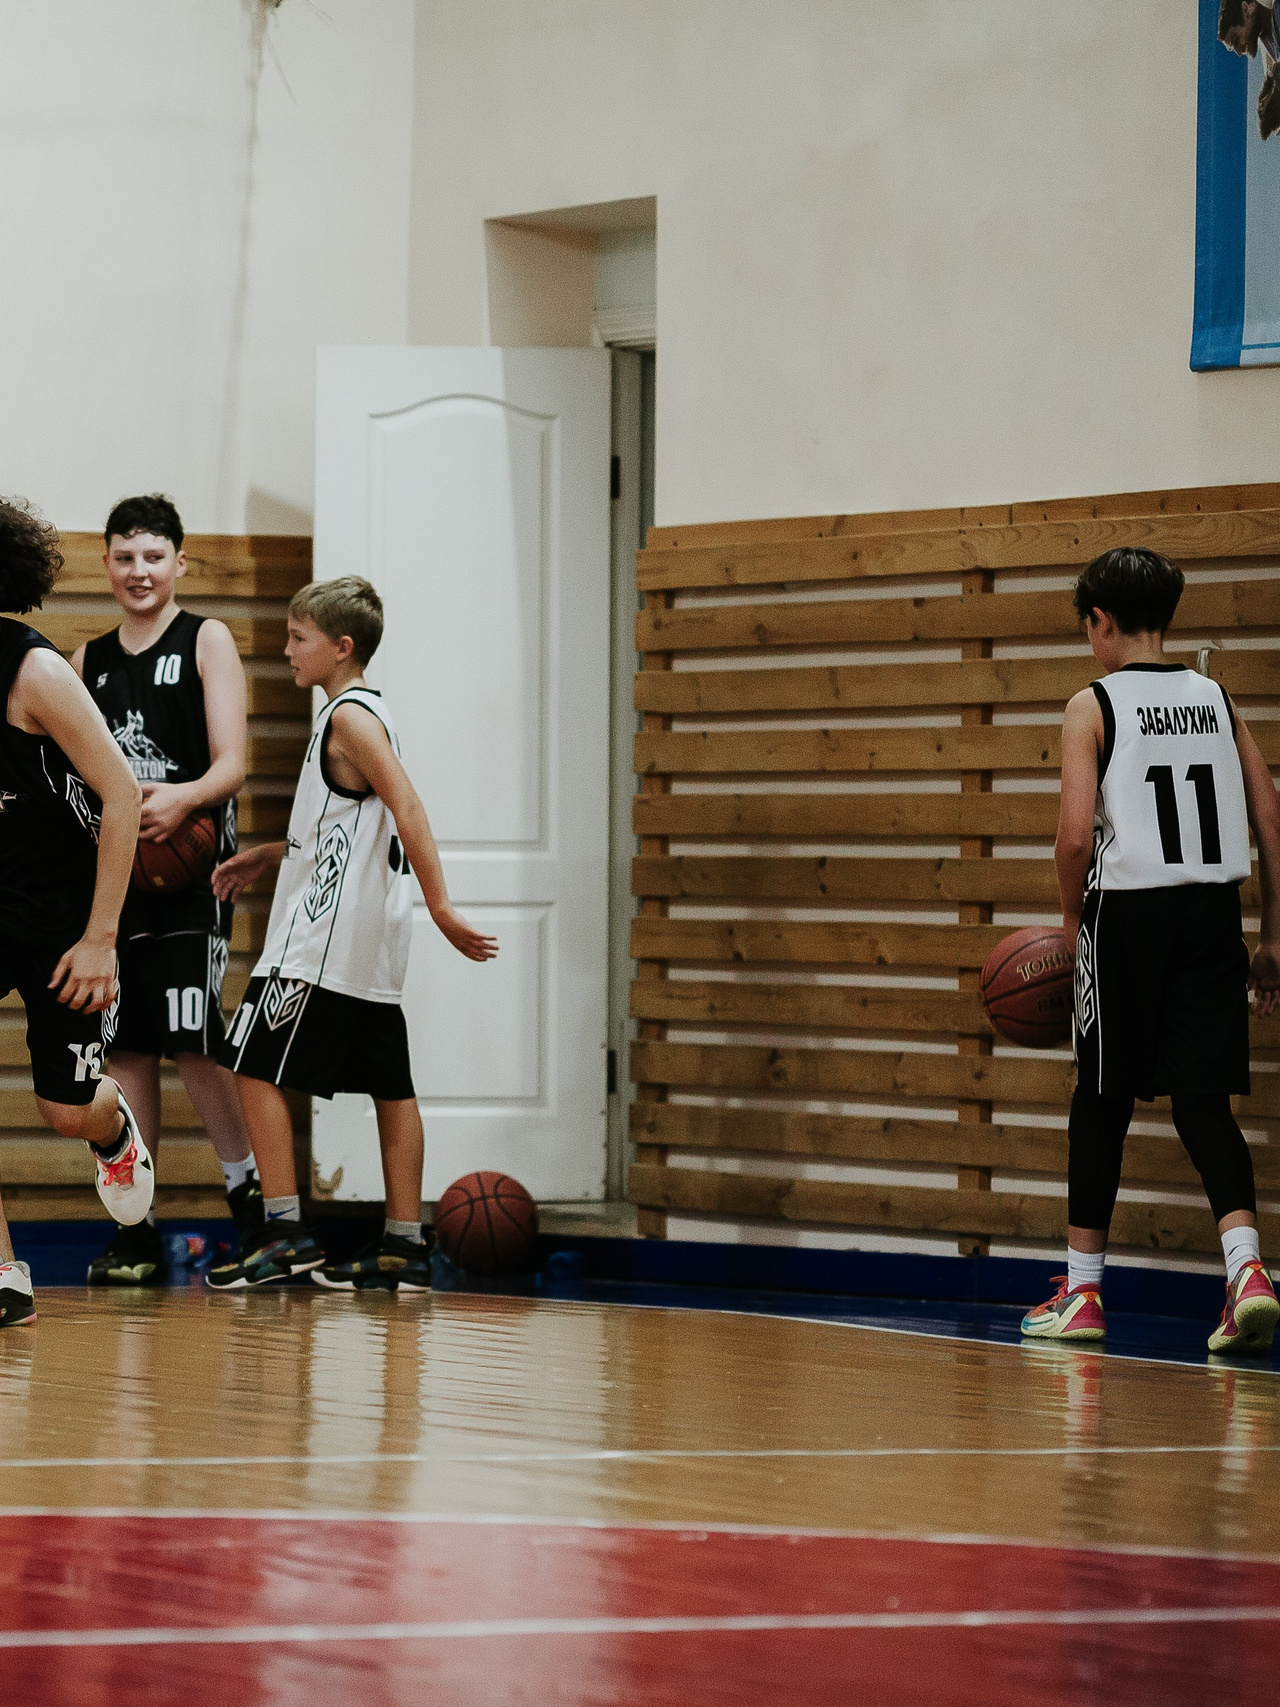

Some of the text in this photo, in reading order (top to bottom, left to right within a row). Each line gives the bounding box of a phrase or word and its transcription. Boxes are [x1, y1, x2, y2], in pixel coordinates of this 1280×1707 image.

[154, 654, 181, 685] 10
[1136, 705, 1219, 735] ЗАБАЛУХИН
[1145, 764, 1222, 865] 11
[166, 987, 204, 1032] 10
[68, 1042, 101, 1081] 16
